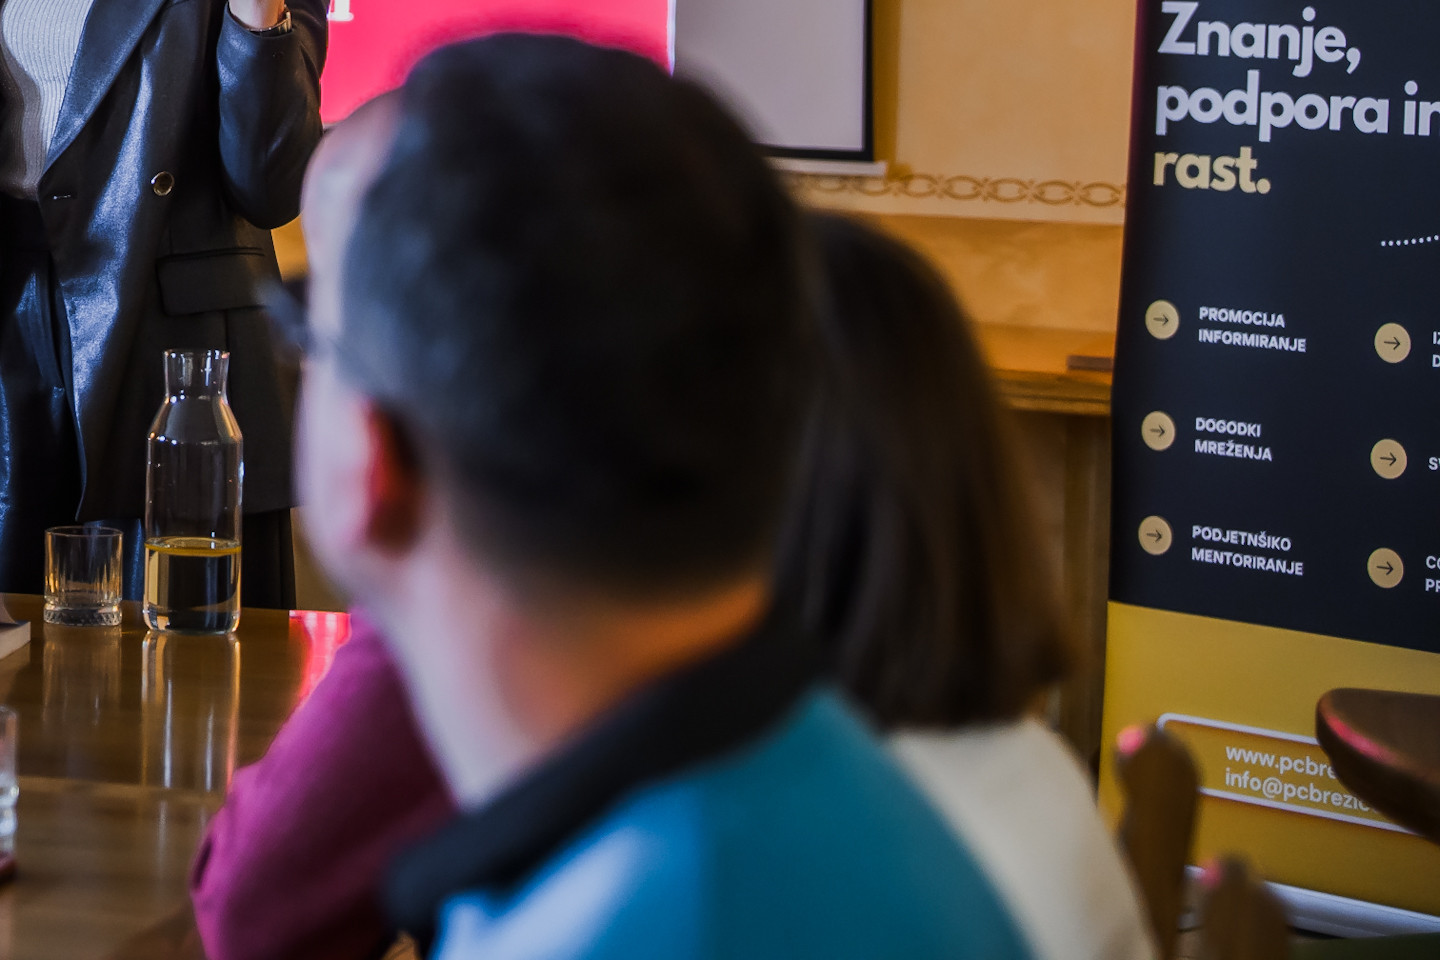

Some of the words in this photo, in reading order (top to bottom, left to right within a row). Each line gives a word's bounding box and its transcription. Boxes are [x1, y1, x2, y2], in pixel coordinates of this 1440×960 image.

[1158, 1, 1361, 77] Znanje,
[1156, 69, 1389, 142] podpora
[1153, 146, 1271, 194] rast.
[1199, 306, 1285, 328] PROMOCIJA
[1198, 328, 1307, 352] INFORMIRANJE
[1195, 417, 1262, 437] DOGODKI
[1194, 439, 1273, 461] MREŽENJA
[1192, 525, 1292, 551] PODJETNŠIKO
[1191, 547, 1304, 576] MENTORIRANJE
[1225, 746, 1338, 780] www.pcbre
